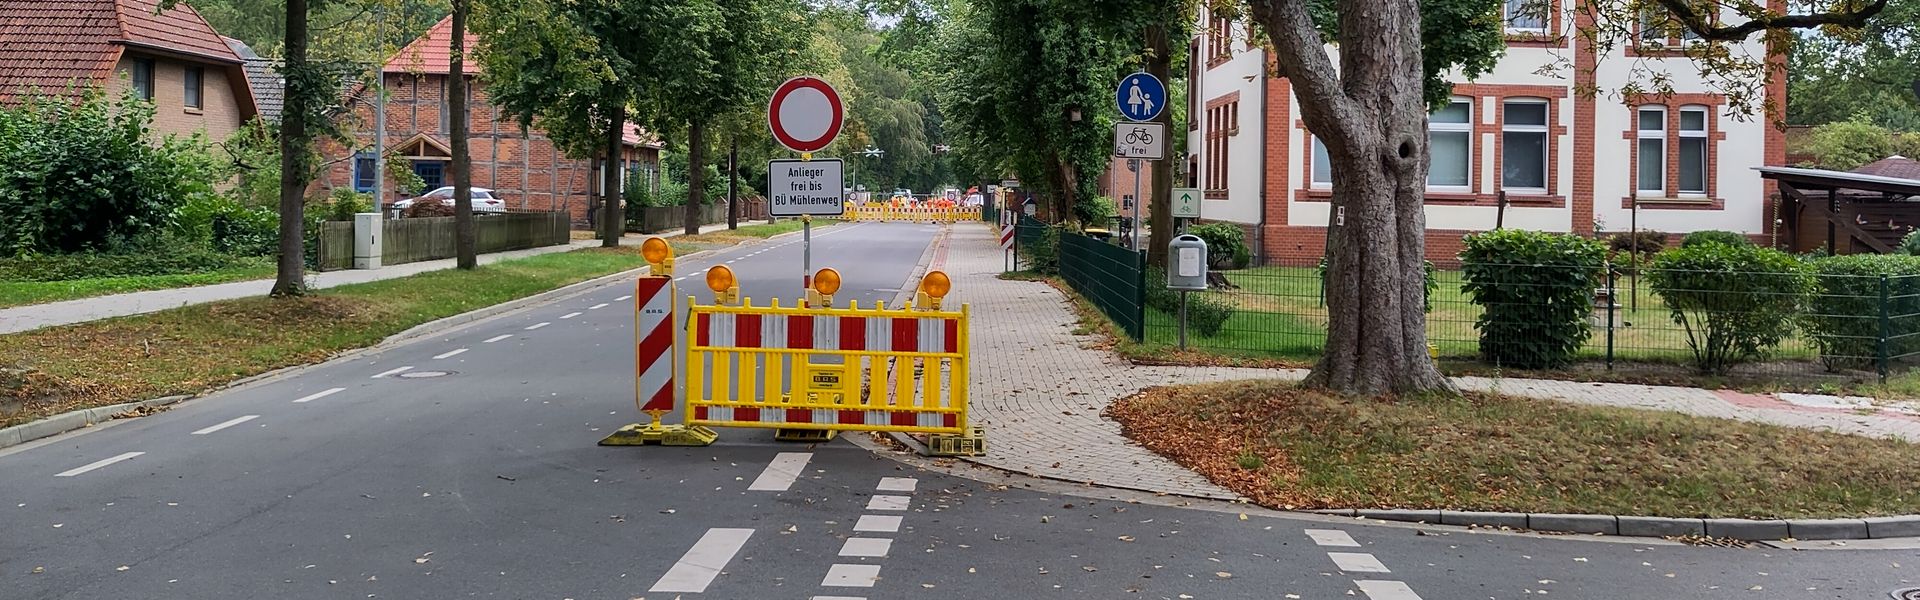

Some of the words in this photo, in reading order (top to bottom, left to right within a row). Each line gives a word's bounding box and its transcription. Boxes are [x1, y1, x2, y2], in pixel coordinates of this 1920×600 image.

[1131, 146, 1147, 154] frei
[788, 167, 824, 179] Anlieger
[791, 181, 806, 191] frei
[809, 181, 822, 191] bis
[775, 194, 786, 205] BÜ
[789, 195, 838, 207] Mühlenweg
